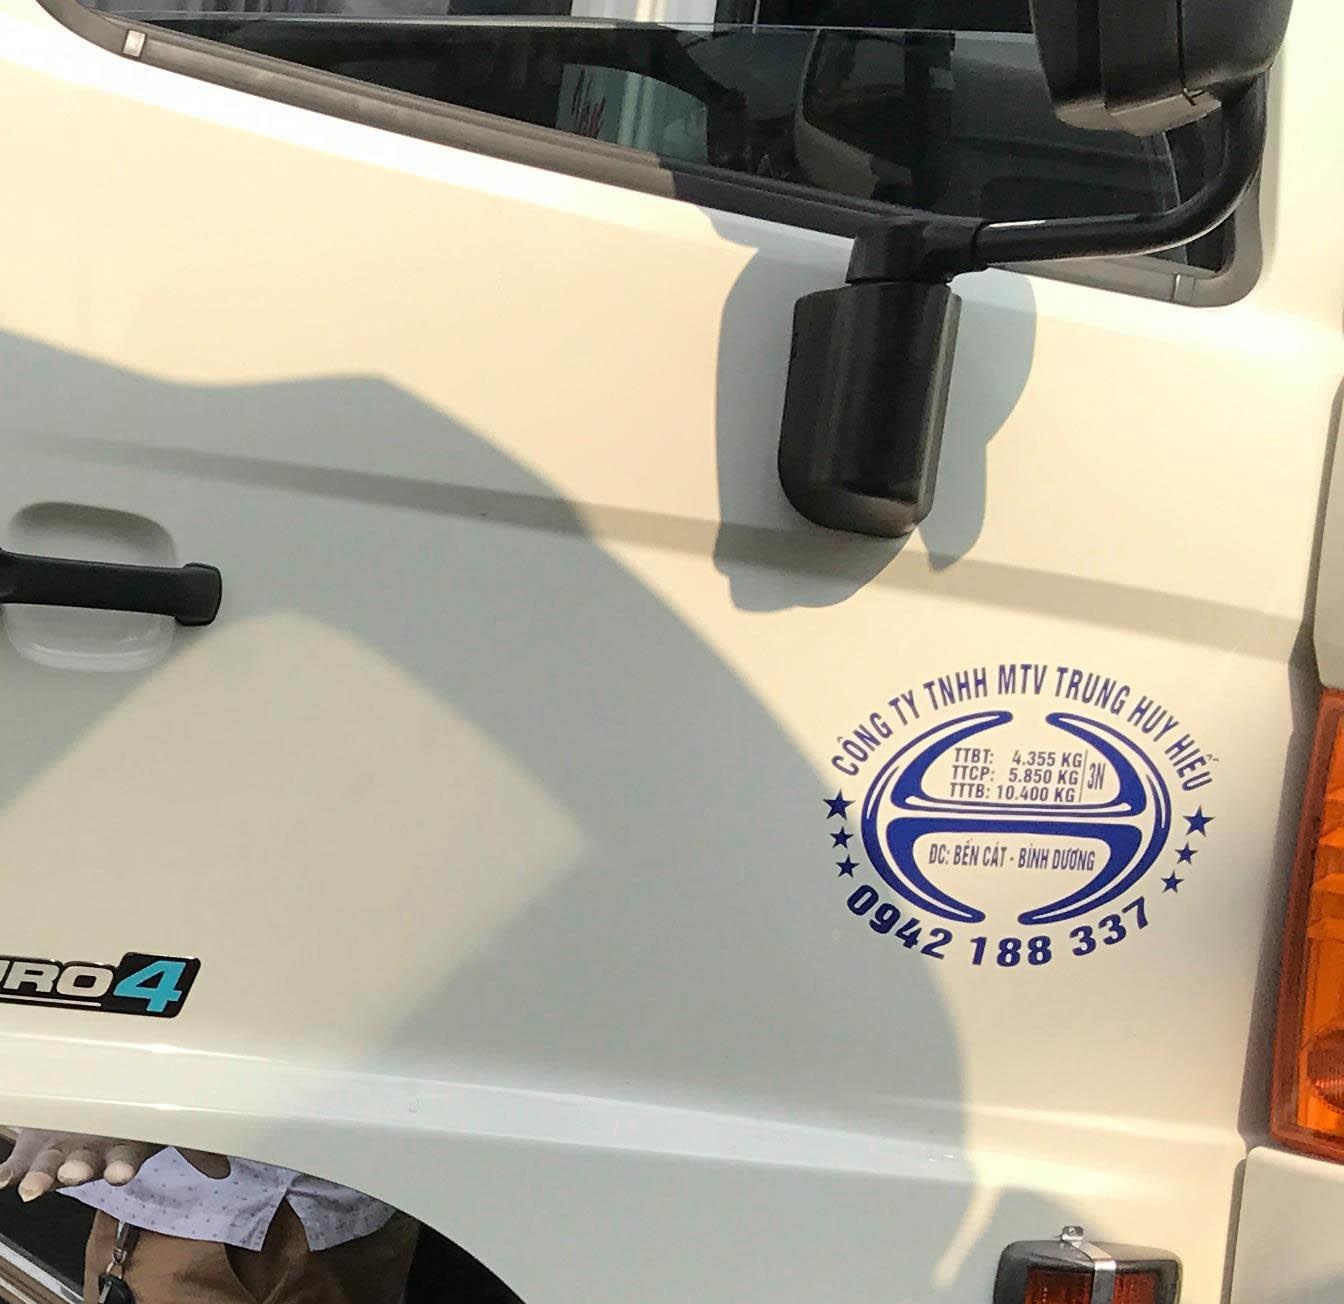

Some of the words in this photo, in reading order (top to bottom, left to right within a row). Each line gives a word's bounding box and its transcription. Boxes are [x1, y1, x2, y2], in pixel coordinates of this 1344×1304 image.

[831, 712, 894, 776] CÔNG
[888, 689, 920, 726] TY
[922, 667, 988, 711] TNHH
[998, 664, 1048, 695] MTV
[1055, 666, 1131, 716] TRUNG
[1127, 695, 1179, 743] HUY
[954, 747, 994, 765] TTBT:
[1012, 750, 1056, 767] 4.355
[1061, 753, 1083, 768] KG
[952, 765, 995, 782] TTCP:
[1008, 768, 1052, 784] 5.850
[1057, 770, 1079, 786] KG
[1087, 762, 1106, 790] 3N
[949, 782, 990, 799] TTTB:
[997, 785, 1049, 802] 10.400
[1054, 787, 1075, 803] KG
[929, 843, 950, 865] ĐC:
[952, 838, 980, 867] BẾN
[982, 842, 1007, 868] CÁT
[1017, 843, 1050, 869] BÌNH
[1051, 847, 1096, 871] DƯƠNG
[846, 884, 953, 959] 0942
[970, 935, 1052, 967] 188
[1069, 896, 1149, 956] 337
